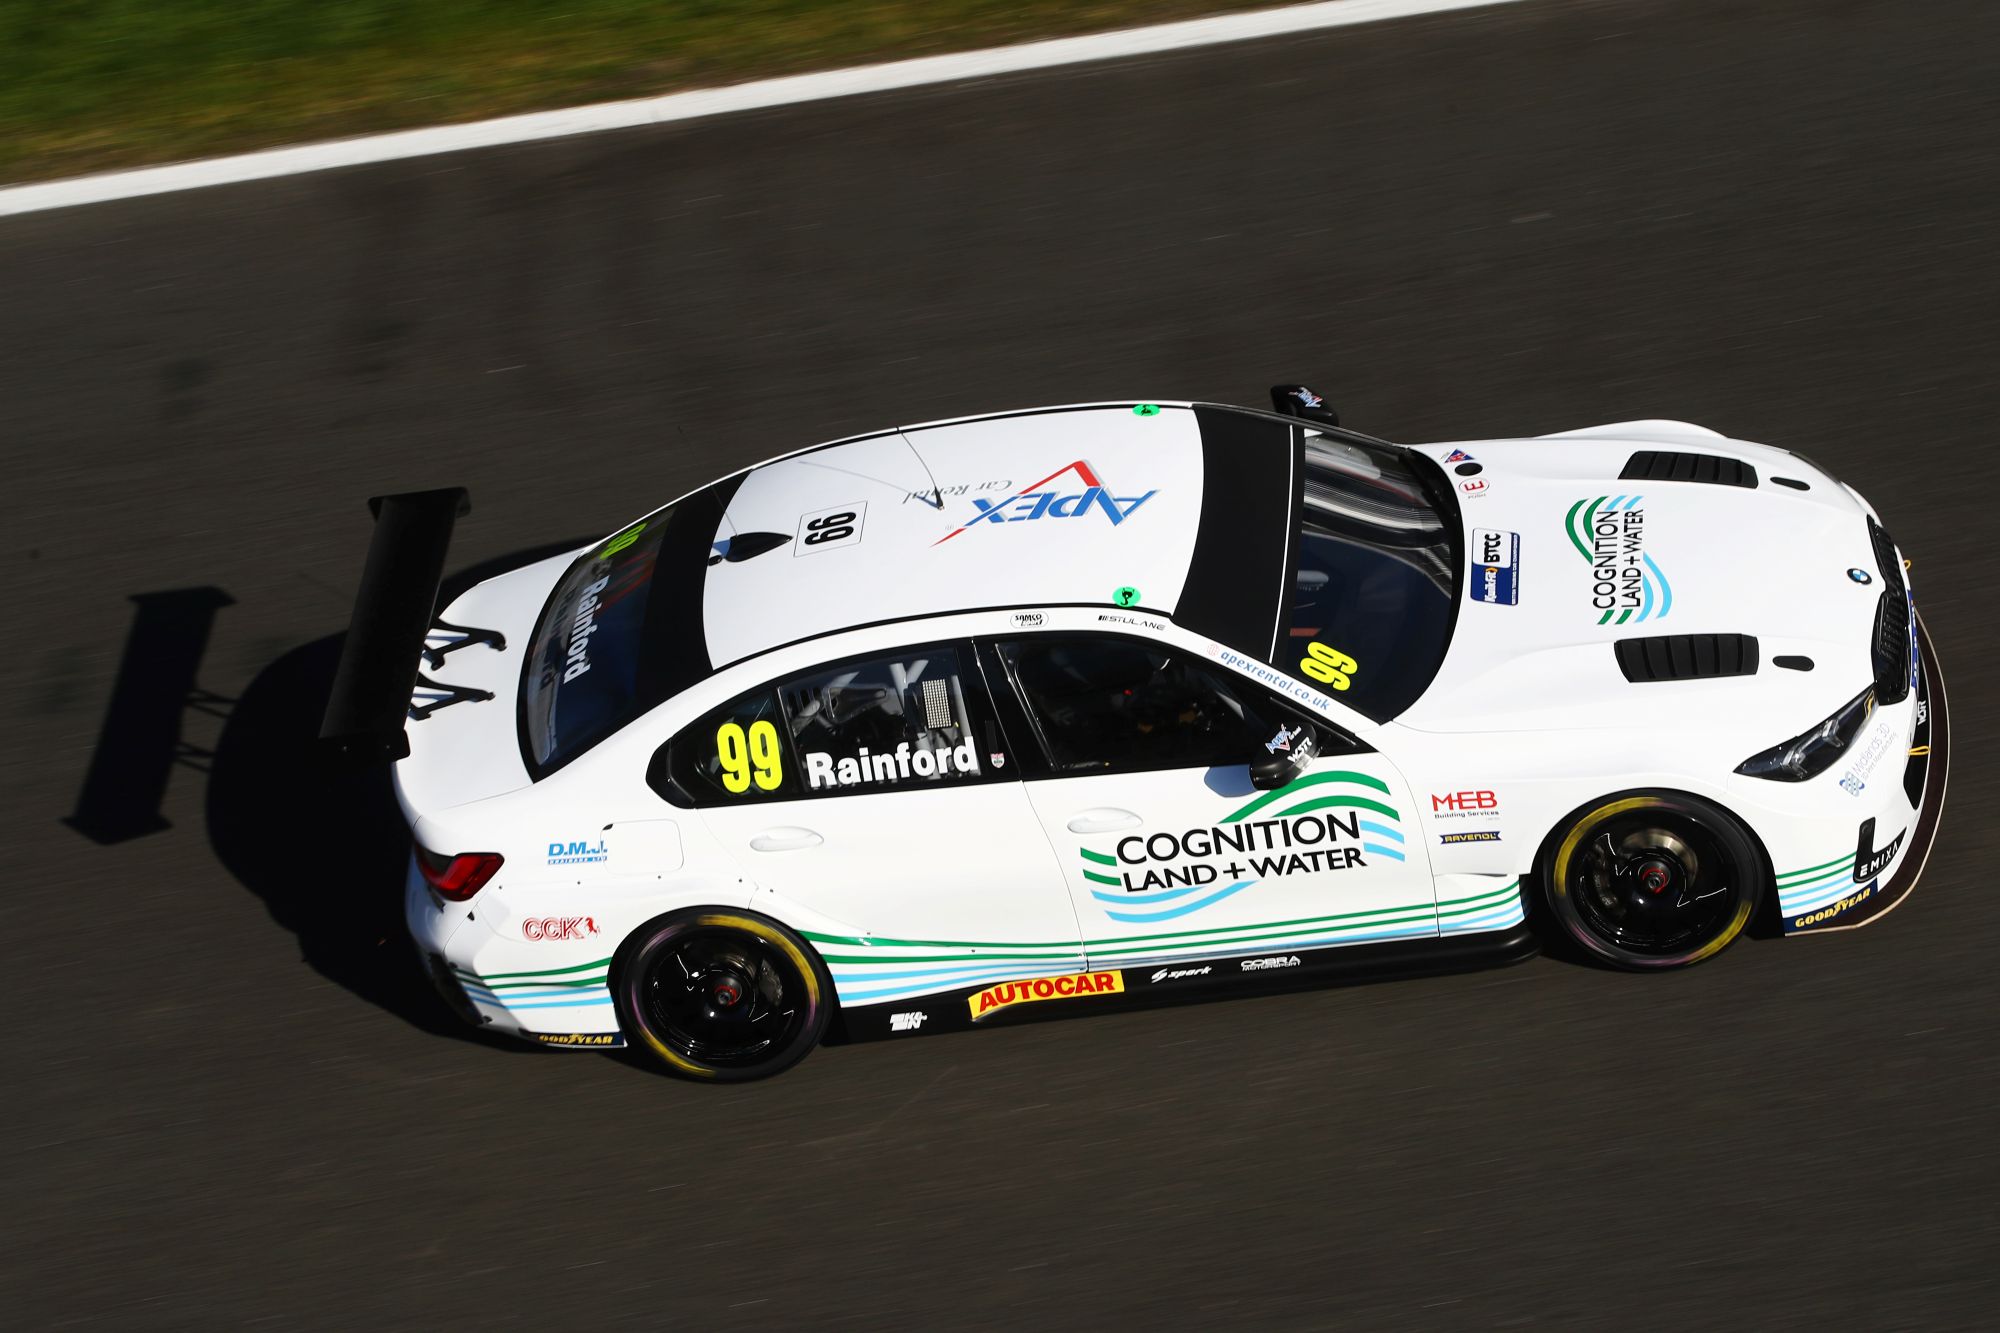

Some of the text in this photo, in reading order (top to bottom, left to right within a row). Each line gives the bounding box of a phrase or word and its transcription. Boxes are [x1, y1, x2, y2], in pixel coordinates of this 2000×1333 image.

[940, 470, 1162, 536] APEX
[974, 478, 1013, 492] Car
[803, 510, 857, 546] 99
[1483, 533, 1502, 563] BTCC
[1592, 510, 1619, 609] COGNITION
[563, 574, 611, 685] Rainford
[1220, 649, 1330, 711] apexrental.co.uk
[1299, 641, 1358, 692] 99
[717, 720, 979, 793] 99 Rainford
[1431, 790, 1498, 812] MEB
[548, 840, 608, 857] D.M.J.
[1116, 811, 1360, 865] COGNITION
[1444, 833, 1497, 843] RAVENOL
[1123, 864, 1218, 893] LAND
[1249, 847, 1368, 879] WATER
[1795, 887, 1871, 928] GOODYEAR
[522, 916, 584, 942] CCK
[1168, 965, 1213, 979] spark
[1241, 955, 1301, 968] COBRA
[978, 973, 1116, 1013] AUTOCAR
